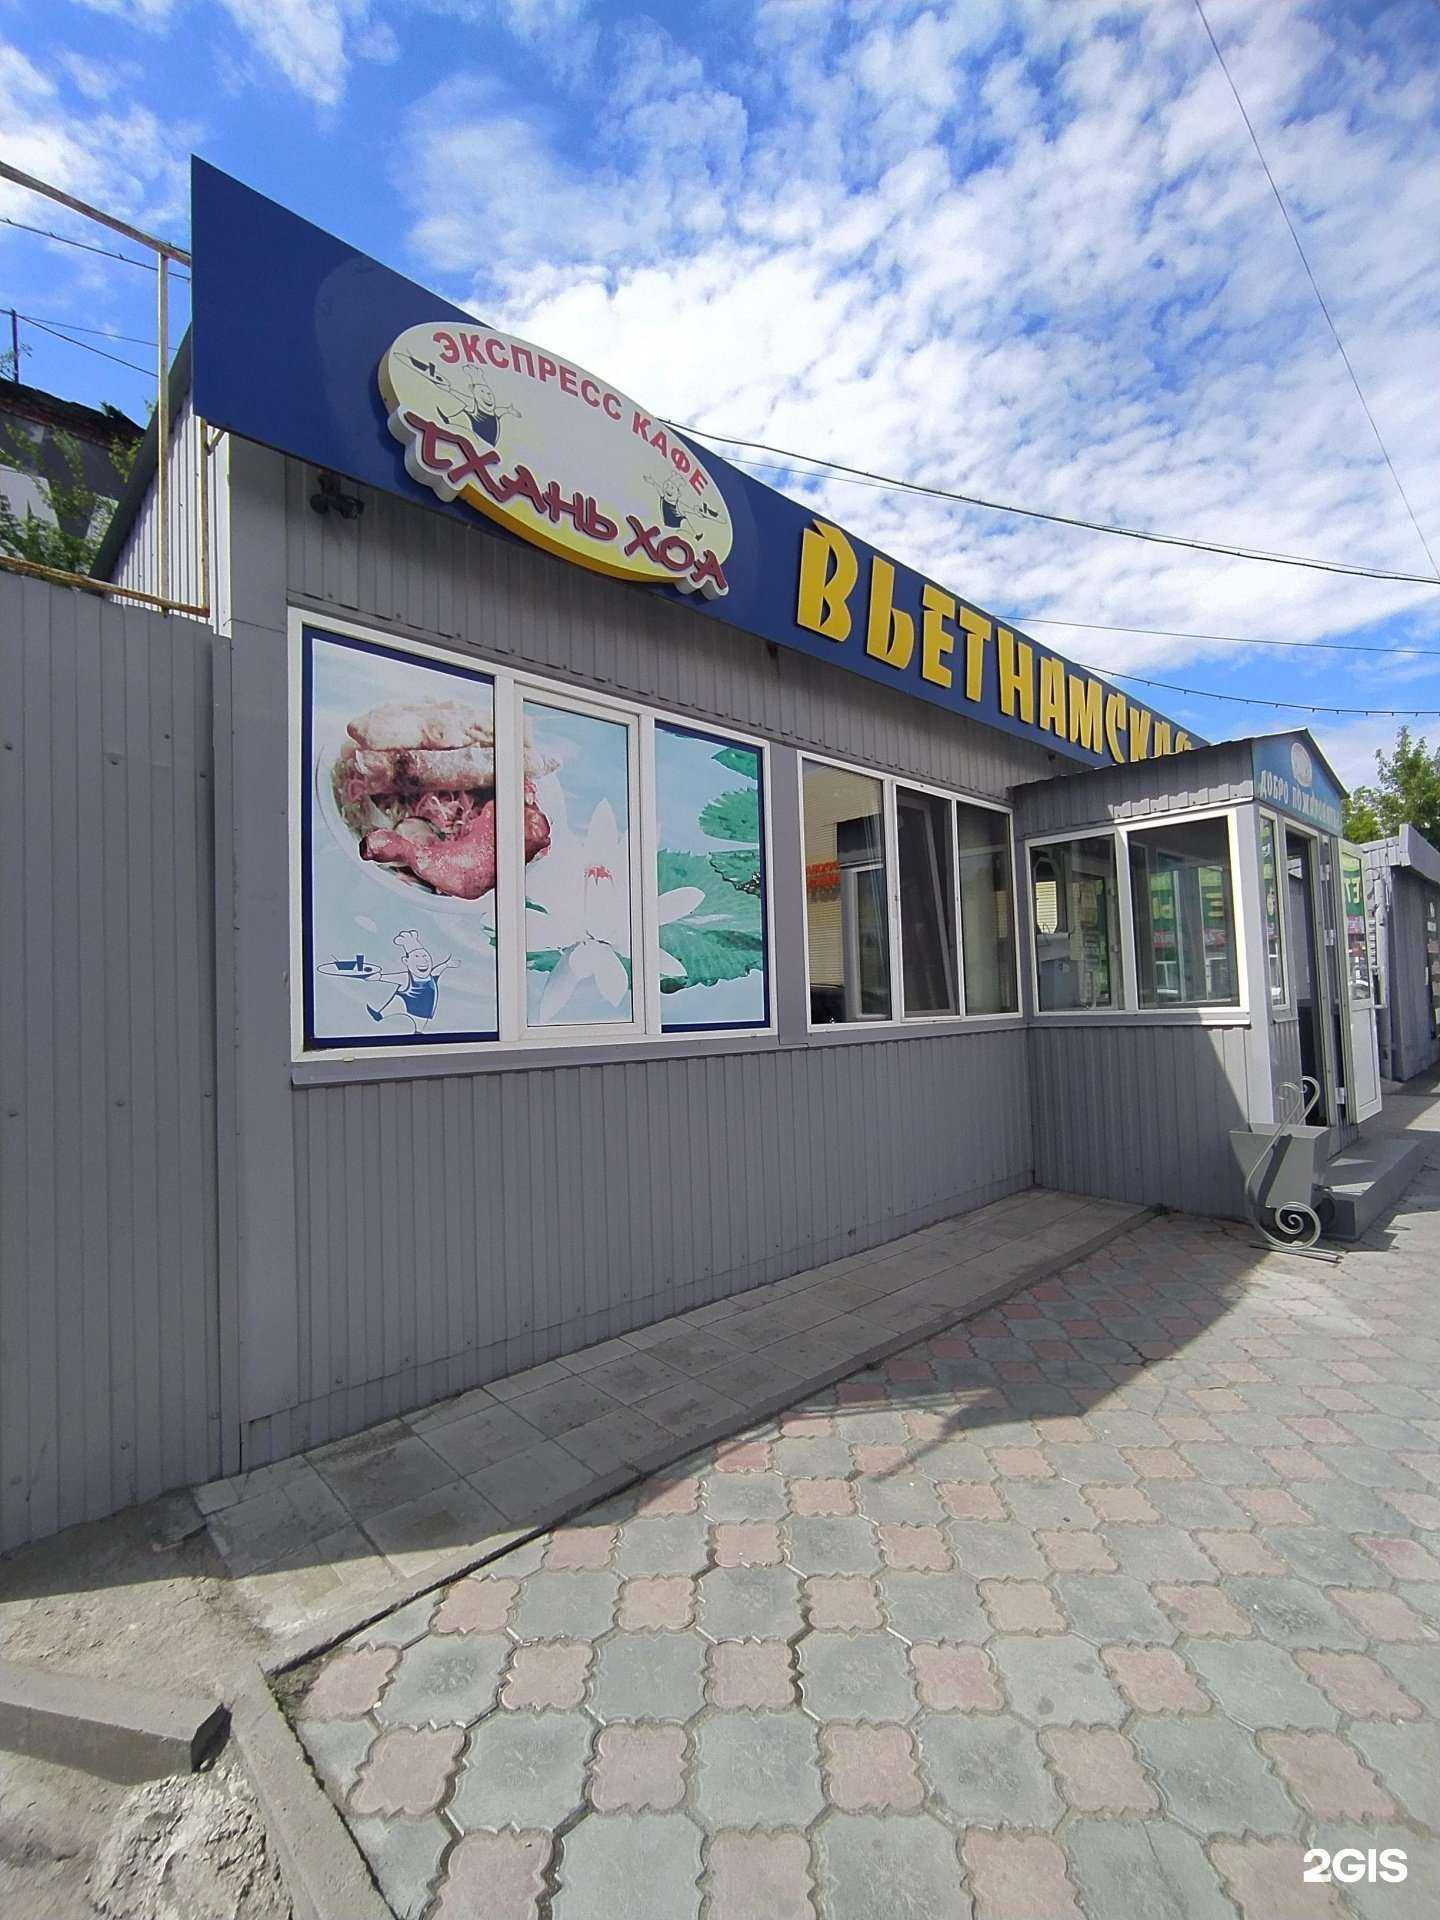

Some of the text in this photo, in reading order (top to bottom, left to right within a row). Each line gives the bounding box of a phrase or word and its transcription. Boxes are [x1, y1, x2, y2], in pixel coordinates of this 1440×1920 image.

[432, 331, 709, 497] ЭКСПРЕСС КАФЕ
[624, 515, 728, 590] ХОА
